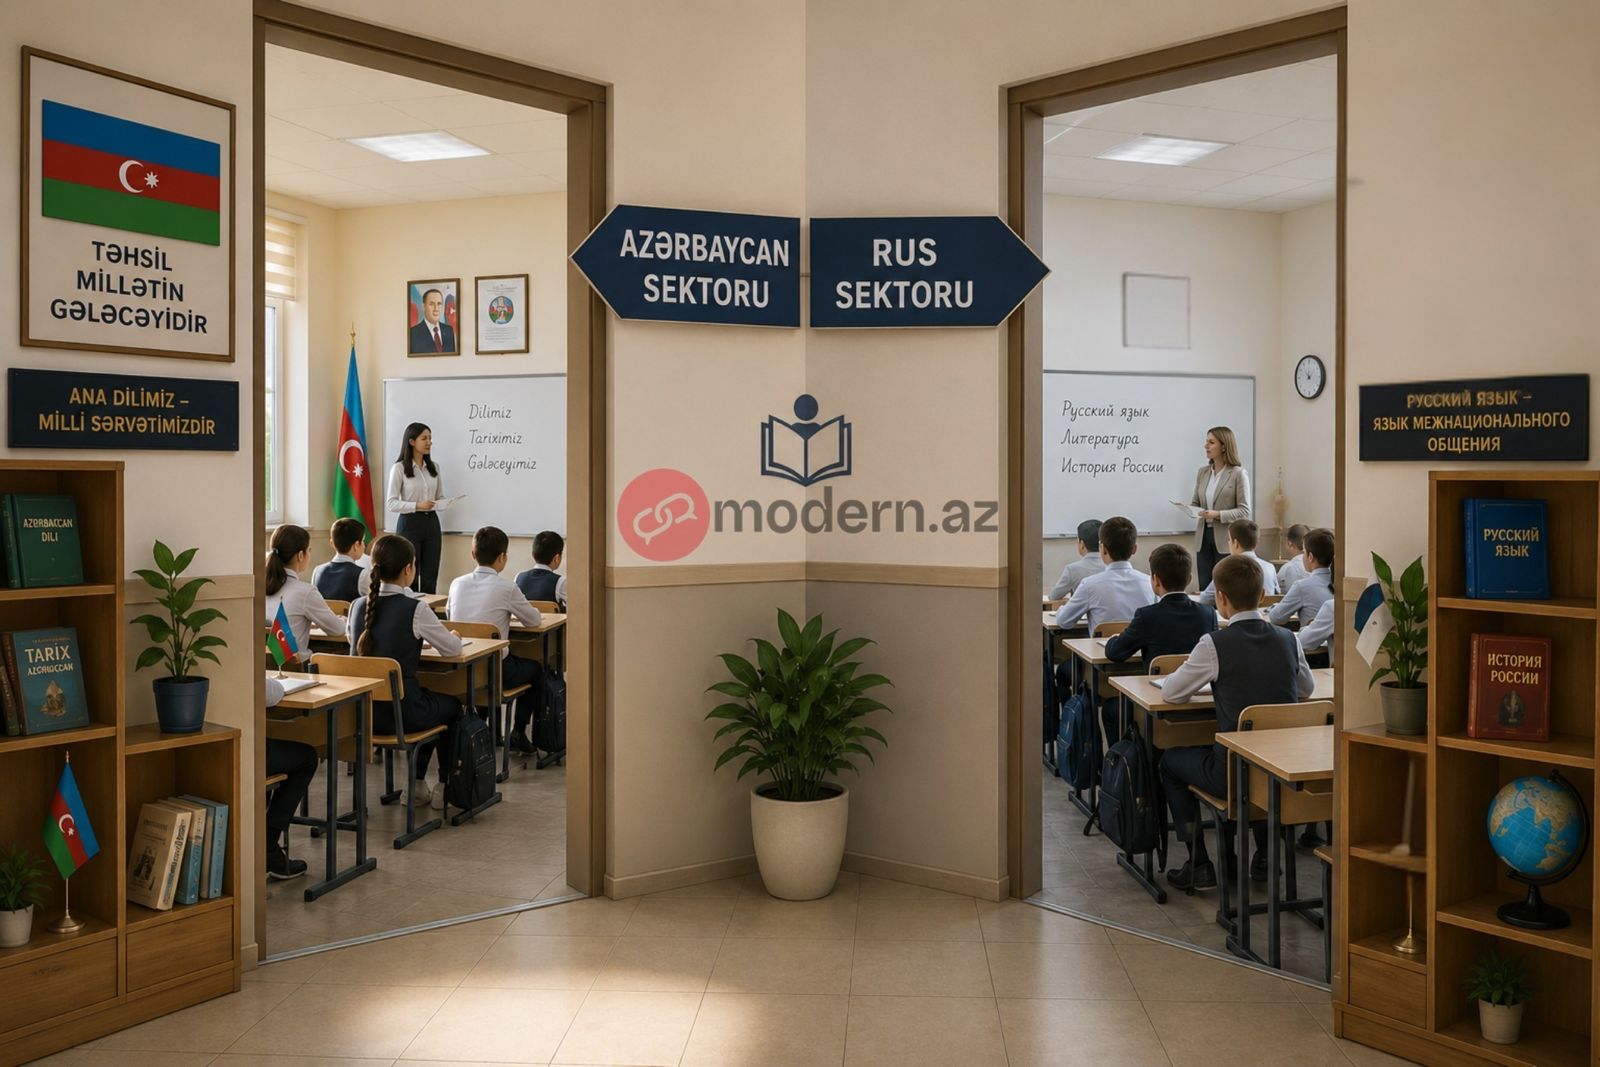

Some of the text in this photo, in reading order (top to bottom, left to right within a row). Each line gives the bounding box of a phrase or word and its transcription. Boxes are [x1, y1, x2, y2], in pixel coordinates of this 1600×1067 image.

[91, 240, 173, 272] TƏHSİL
[620, 228, 790, 267] AZƏRBAYCAN
[872, 238, 938, 267] RUS
[76, 268, 184, 302] MİLLƏTİN
[643, 273, 770, 309] SEKTORU
[835, 280, 974, 309] SEKTORU
[50, 298, 208, 334] GƏLƏCƏYİDİR
[69, 387, 107, 406] ANA
[113, 386, 175, 408] DİLİMİZ
[1407, 390, 1472, 409] РУССКИЙ
[1476, 390, 1518, 406] ЯЗЫК
[468, 403, 512, 420] Dilimiz
[1062, 400, 1150, 422] Русский язык
[1373, 411, 1571, 431] ЯЗЫК МЕЖНАЦИОНАЛЬНОГО
[39, 410, 215, 435] MİLLİ SƏRVƏTİMİZDİR
[468, 429, 522, 444] Tariximiz
[1060, 428, 1140, 449] Литература
[1427, 436, 1501, 454] ОБЩЕНИЯ
[1061, 456, 1164, 478] История России
[1483, 526, 1540, 542] РУССКИЙ
[1495, 545, 1529, 557] ЯЗЫК
[24, 642, 71, 663] TARİX
[1487, 653, 1542, 668] ИСТОРИЯ
[1490, 670, 1539, 685] РОССИИ
